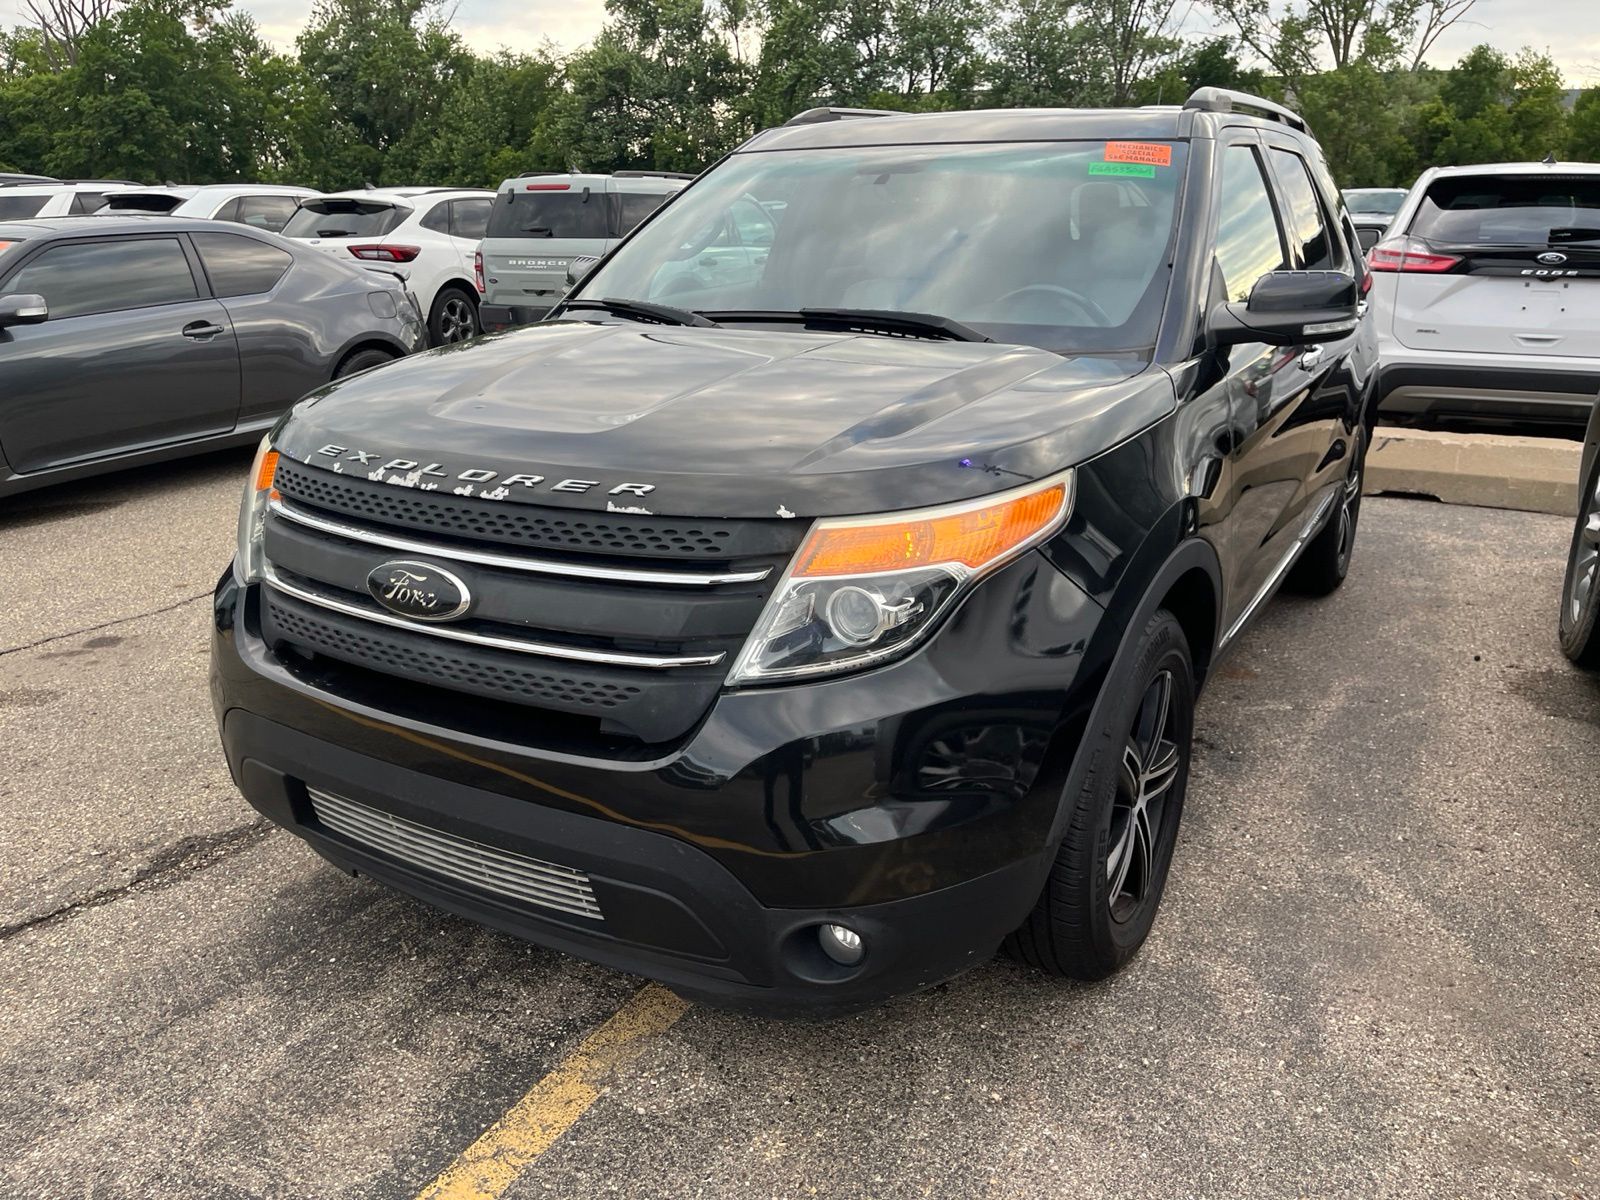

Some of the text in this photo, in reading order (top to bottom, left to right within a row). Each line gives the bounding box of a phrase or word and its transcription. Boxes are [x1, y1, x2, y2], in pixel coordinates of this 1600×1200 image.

[1115, 143, 1164, 152] MECHANICS
[1125, 155, 1168, 164] MANAGER
[318, 443, 656, 497] EXPLORER
[384, 569, 440, 608] Ford
